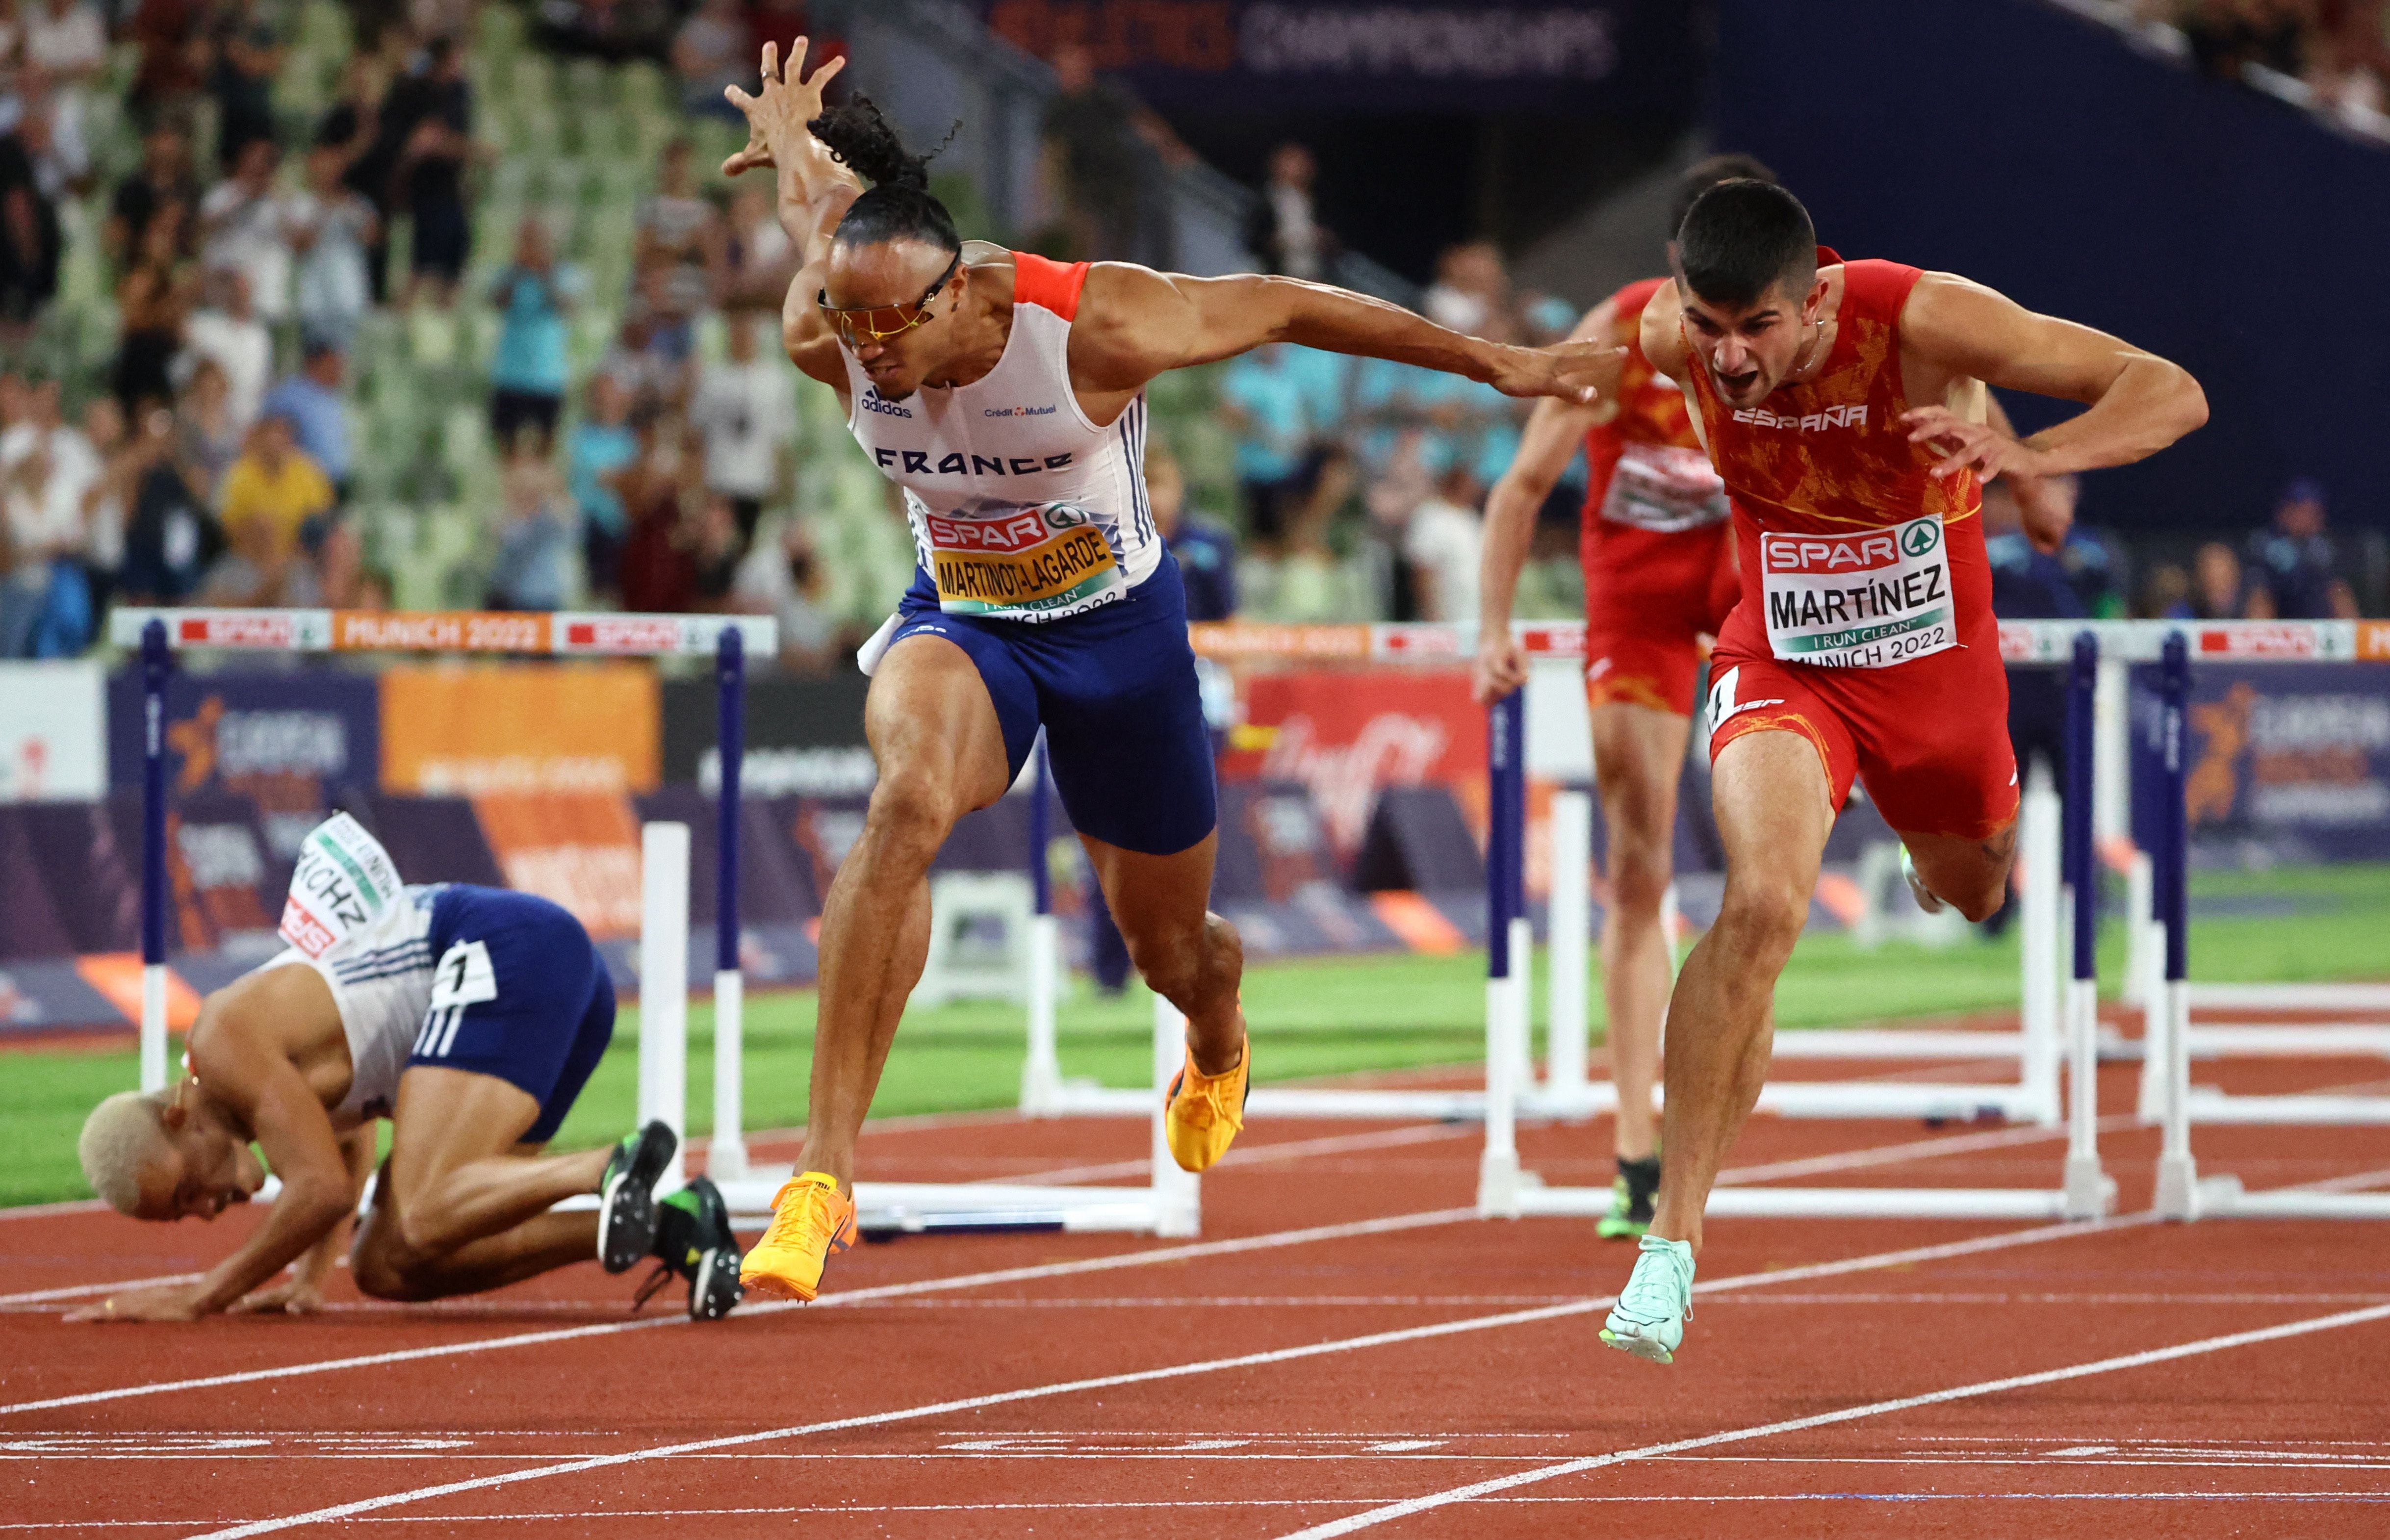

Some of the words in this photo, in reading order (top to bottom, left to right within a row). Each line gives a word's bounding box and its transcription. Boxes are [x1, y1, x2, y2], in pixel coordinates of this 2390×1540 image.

[861, 398, 912, 418] adidas
[984, 408, 1013, 417] Crédit
[1026, 405, 1056, 415] Mutuel
[1732, 405, 1868, 432] ESPAÑA
[875, 447, 1073, 475] FRANCE
[930, 517, 1043, 547] SPAR
[939, 531, 1107, 598] MARTINOT-LAGARDE
[1769, 538, 1895, 569] SPAR
[1770, 564, 1946, 630] MARTÍNEZ
[1788, 645, 1882, 667] NICH
[1891, 627, 1945, 659] 2022
[1824, 631, 1857, 647] RUN
